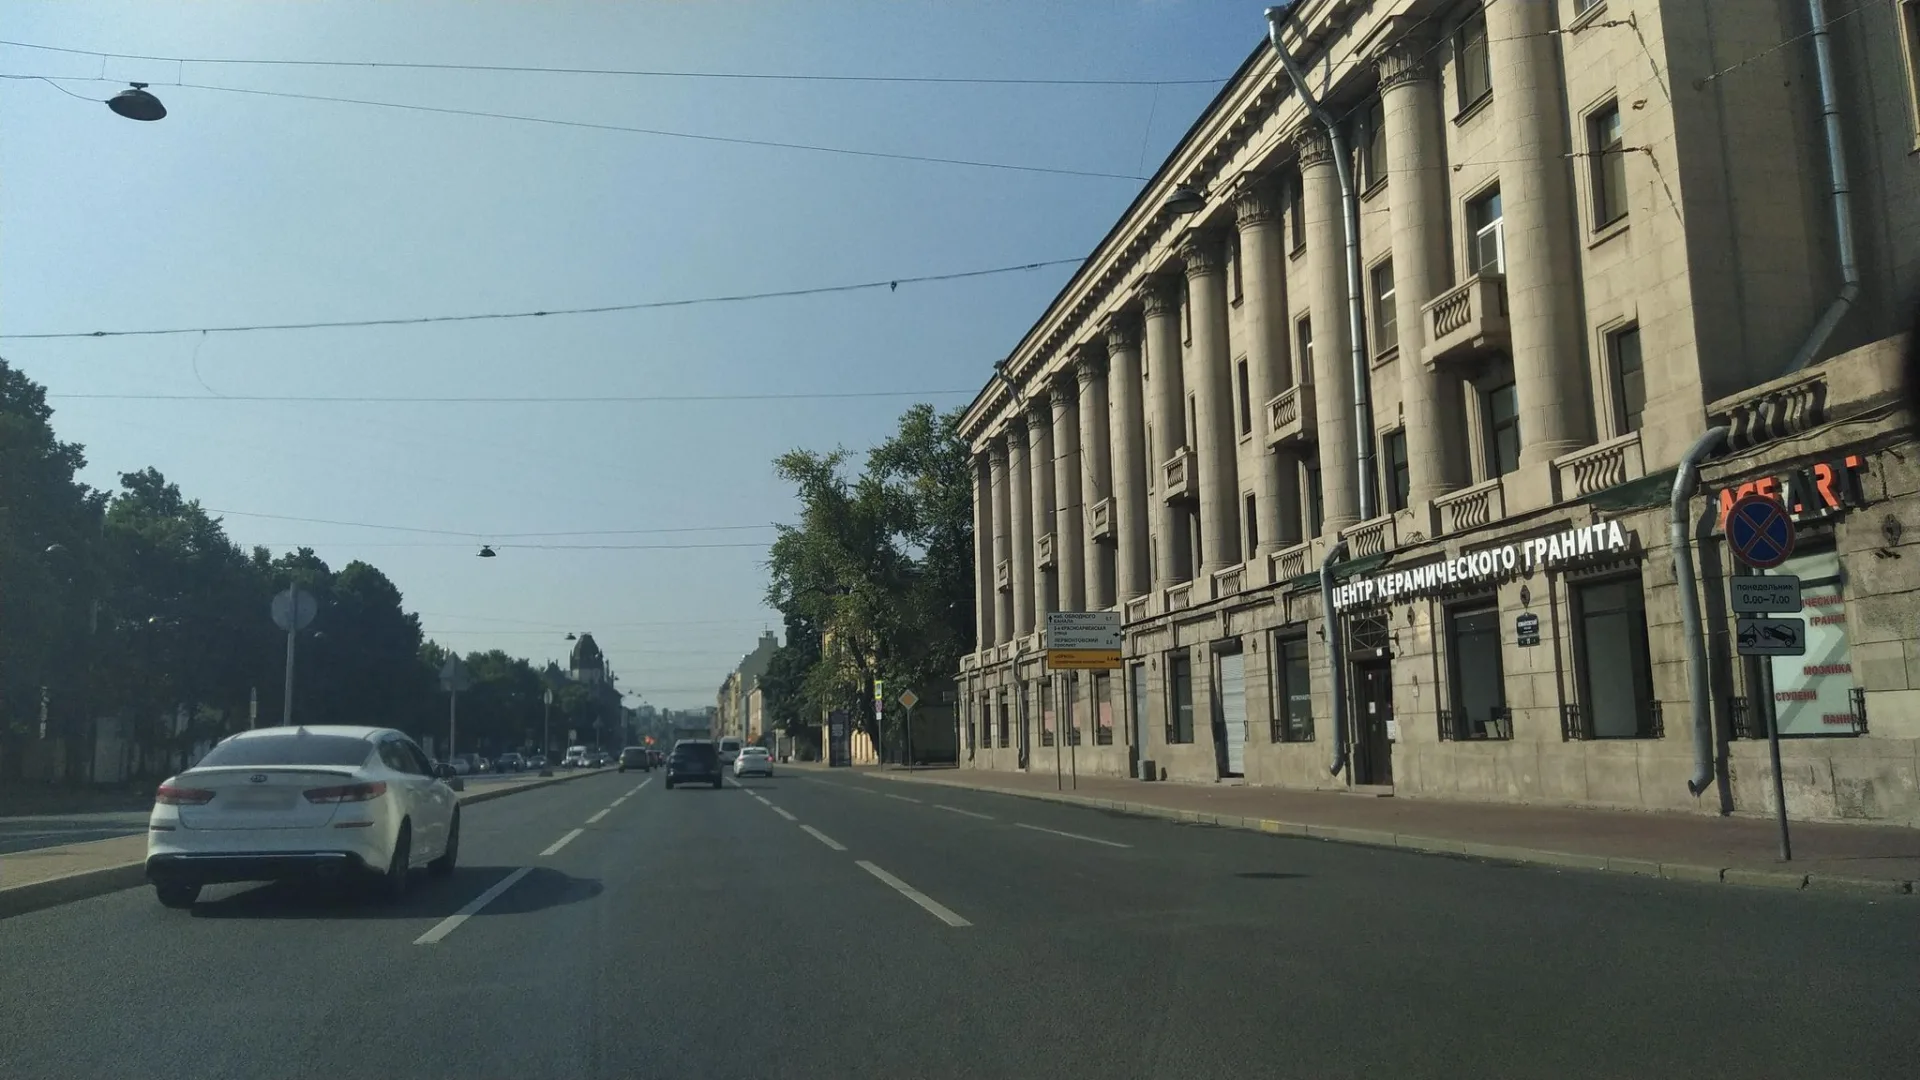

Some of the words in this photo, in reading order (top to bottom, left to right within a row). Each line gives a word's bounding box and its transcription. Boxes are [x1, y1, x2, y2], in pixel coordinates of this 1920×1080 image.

[1331, 581, 1374, 608] ЦЕНТР
[1377, 545, 1516, 599] КЕРАМИЧЕСКОГО
[1524, 519, 1625, 568] ГРАНИТА
[1809, 613, 1847, 627] ГРАНИТ
[1803, 663, 1852, 676] МОЗАИКА
[1775, 690, 1817, 702] СТУПЕНИ
